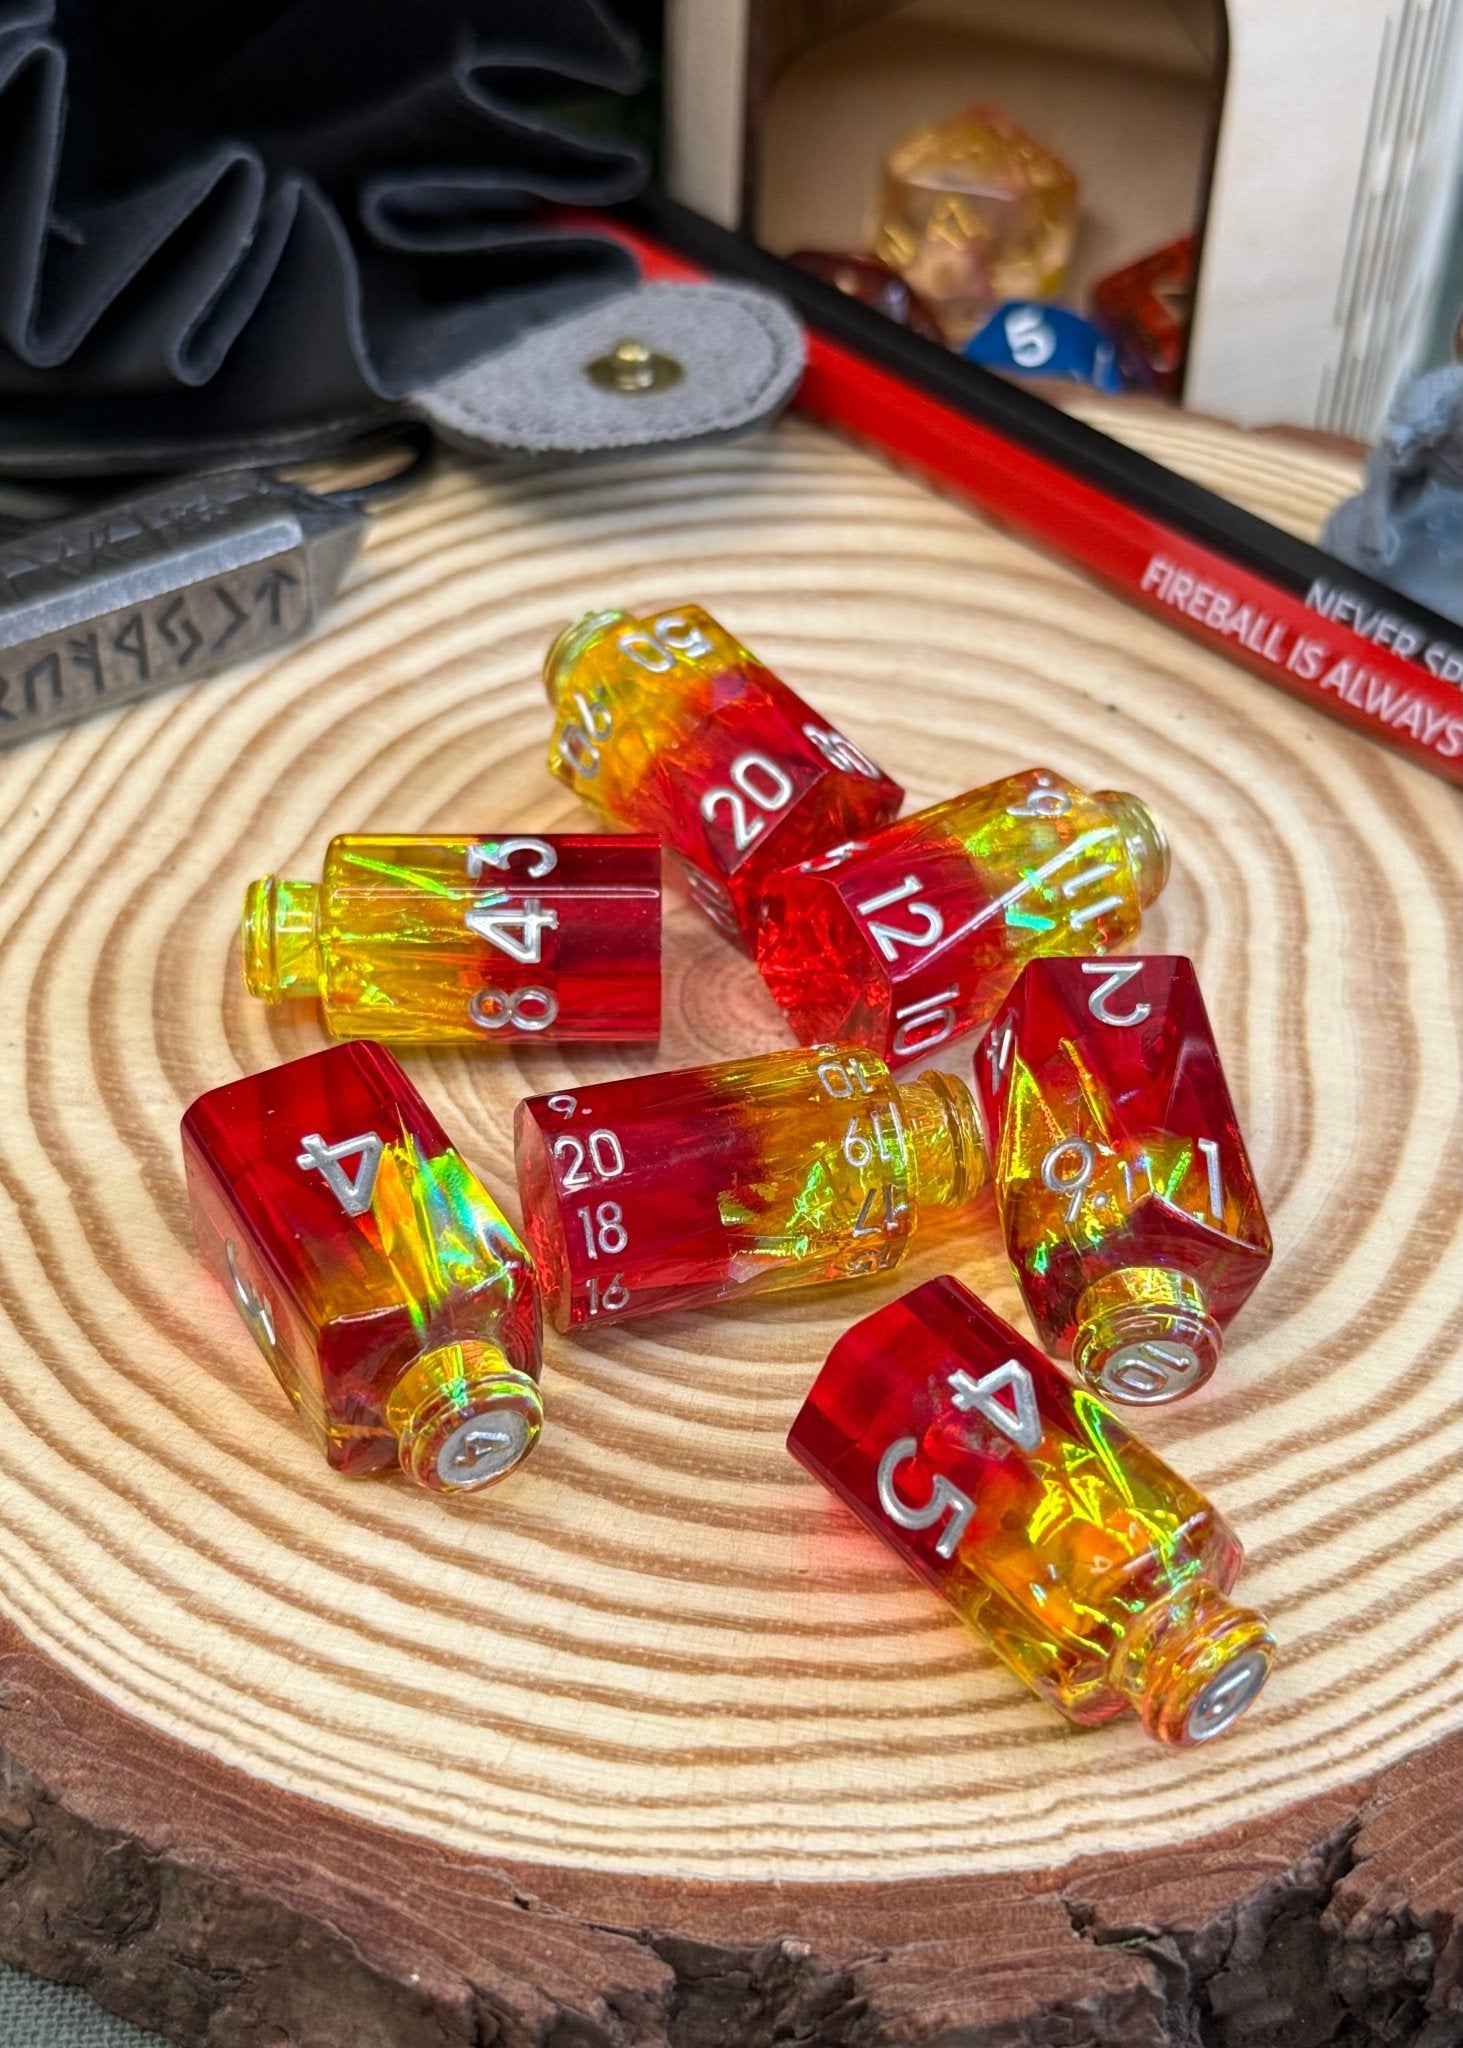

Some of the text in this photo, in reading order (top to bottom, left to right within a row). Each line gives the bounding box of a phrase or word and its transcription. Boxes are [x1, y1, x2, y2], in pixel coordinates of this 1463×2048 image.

[1004, 305, 1056, 367] 5
[617, 616, 714, 672] 50
[1304, 577, 1424, 661] NEVER
[1140, 555, 1463, 757] FIREBALL IS ALWAYS
[702, 752, 792, 850] 20
[465, 898, 558, 965] 4
[857, 875, 944, 963] 12
[468, 986, 558, 1031] 8
[892, 984, 960, 1056] 10
[1080, 961, 1152, 1028] 2
[296, 1130, 384, 1217] 4
[552, 1128, 625, 1188] 20
[576, 1200, 628, 1260] 18
[585, 1272, 630, 1316] 16
[947, 1358, 1045, 1453] 4
[876, 1437, 976, 1560] 5
